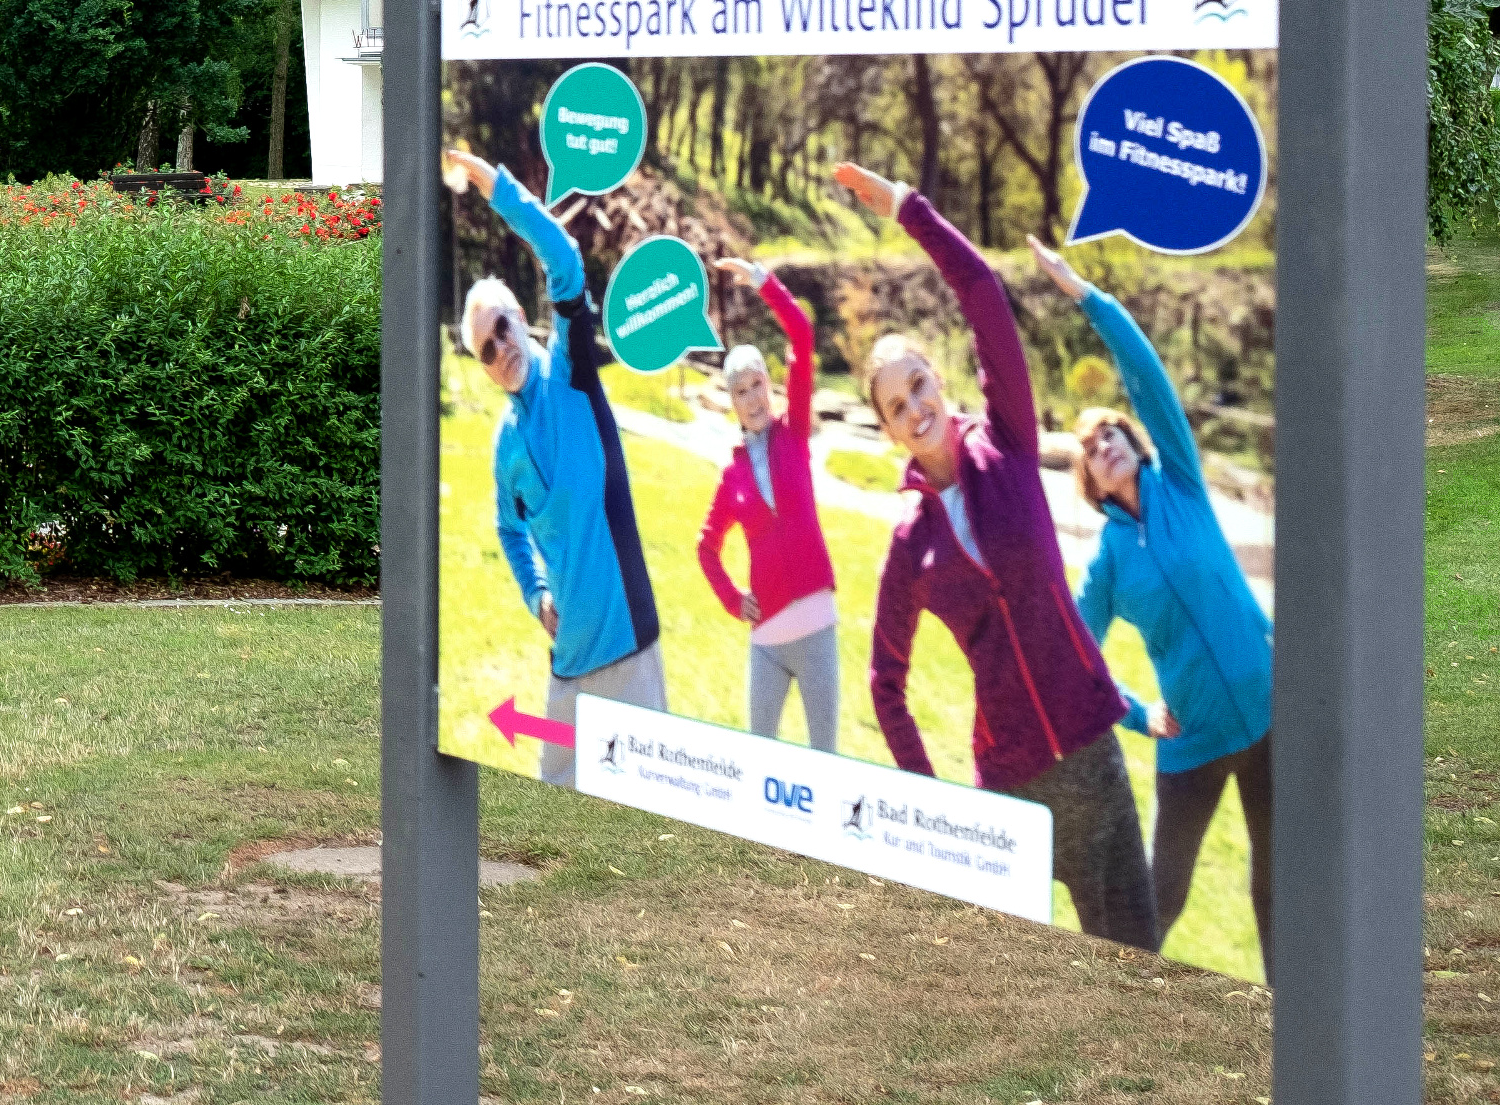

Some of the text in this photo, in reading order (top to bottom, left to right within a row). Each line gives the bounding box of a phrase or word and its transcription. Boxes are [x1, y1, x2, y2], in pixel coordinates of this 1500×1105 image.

[558, 107, 629, 134] Bewegung
[1124, 109, 1220, 153] Viel Spaß
[566, 133, 619, 155] tut gut!
[1088, 131, 1249, 194] im Fitnesspark!
[628, 734, 654, 758] Bad
[877, 799, 908, 825] Bad
